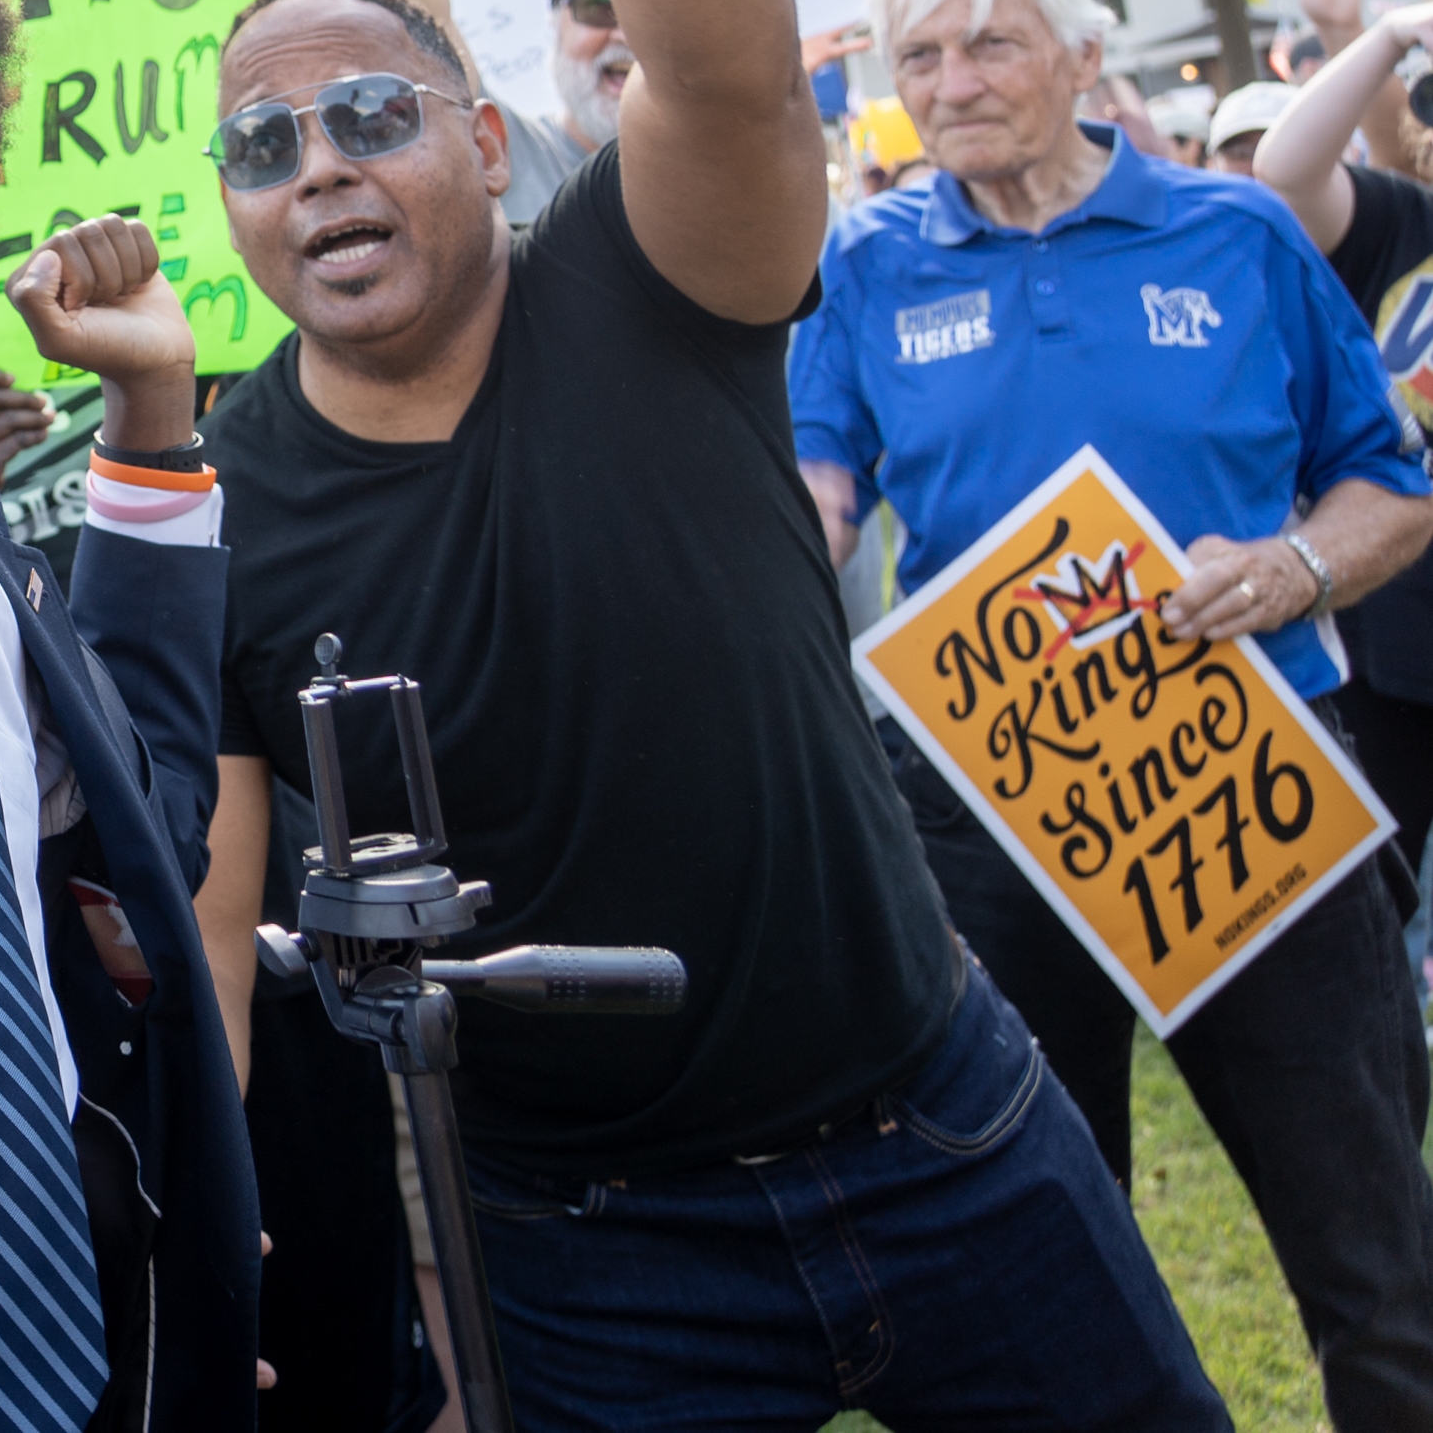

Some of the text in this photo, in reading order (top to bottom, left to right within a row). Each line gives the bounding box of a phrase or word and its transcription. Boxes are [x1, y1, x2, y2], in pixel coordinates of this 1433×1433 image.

[935, 516, 1070, 722] No
[1039, 662, 1249, 882] Since
[1122, 727, 1315, 968] 1776
